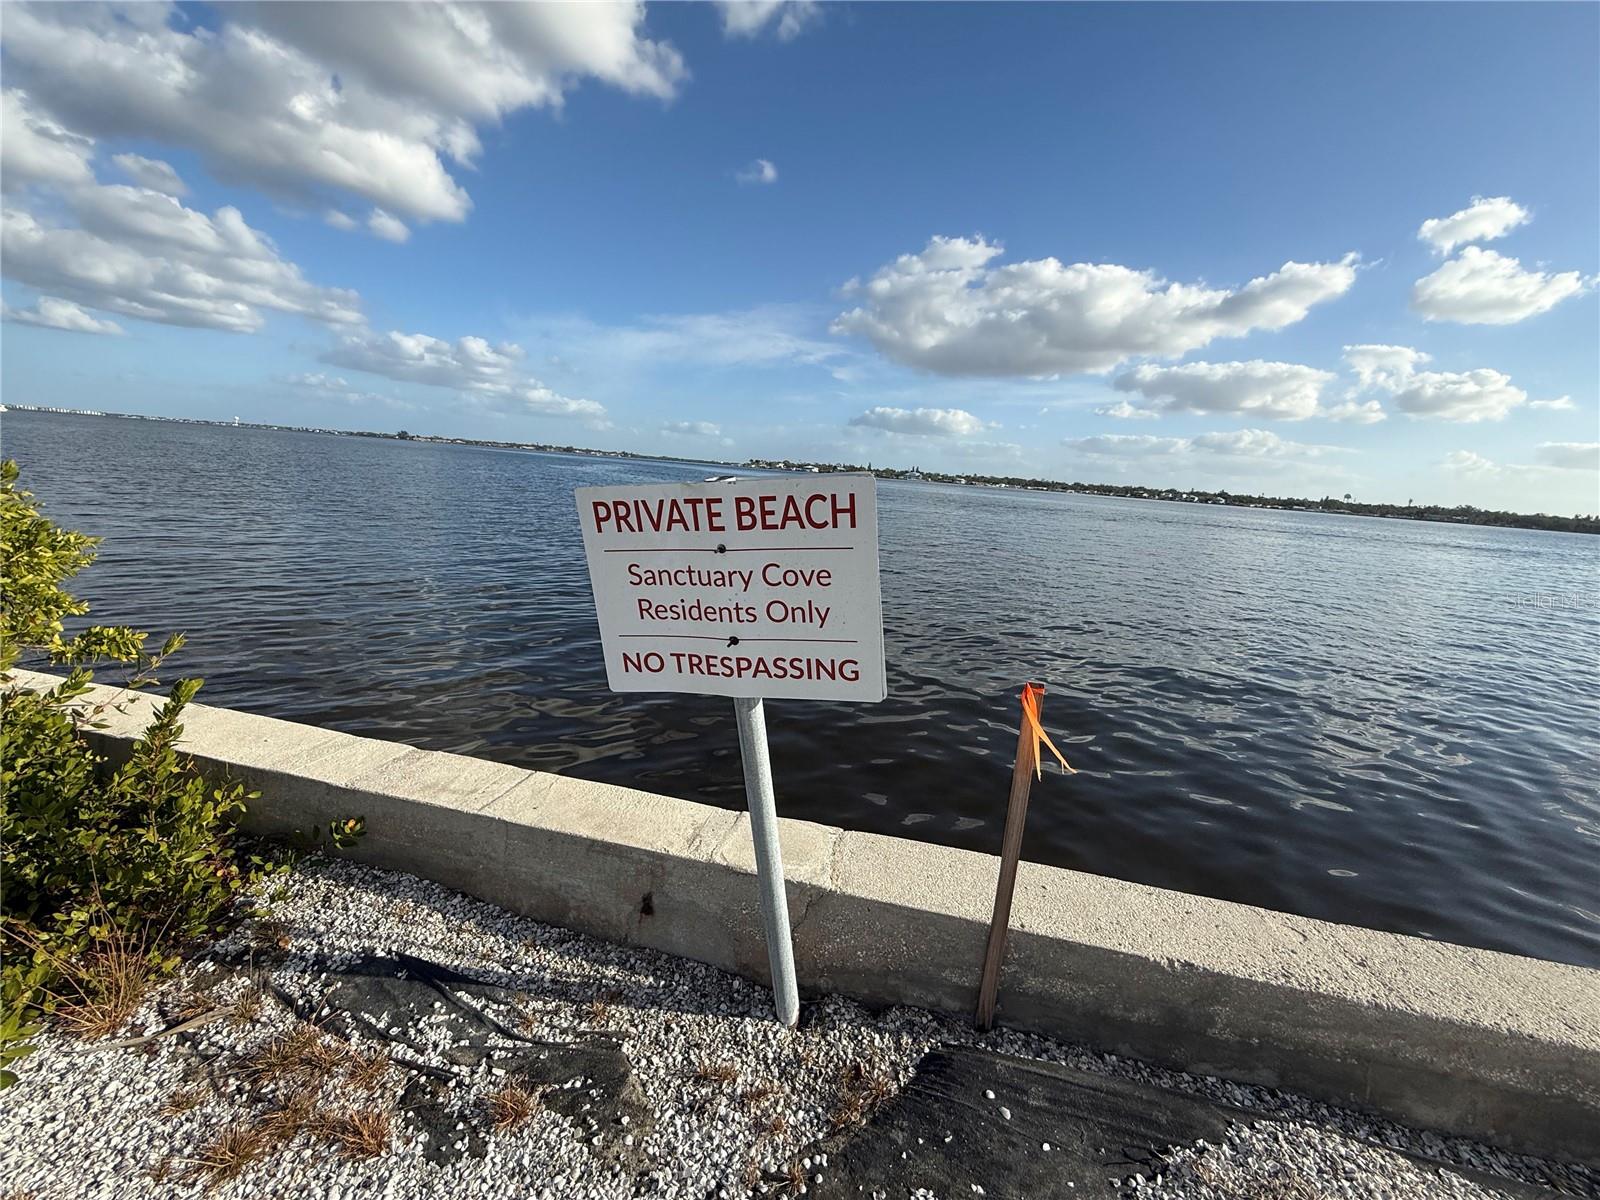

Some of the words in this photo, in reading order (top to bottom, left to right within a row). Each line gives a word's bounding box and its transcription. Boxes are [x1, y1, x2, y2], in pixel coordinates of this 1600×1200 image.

[591, 497, 726, 533] PRIVATE
[734, 492, 857, 531] BEACH
[627, 563, 753, 592] Sanctuary
[761, 562, 832, 587] Cove
[637, 598, 757, 624] Residents
[765, 599, 831, 629] Only
[621, 652, 665, 673] NO
[669, 652, 860, 681] TRESPASSING
